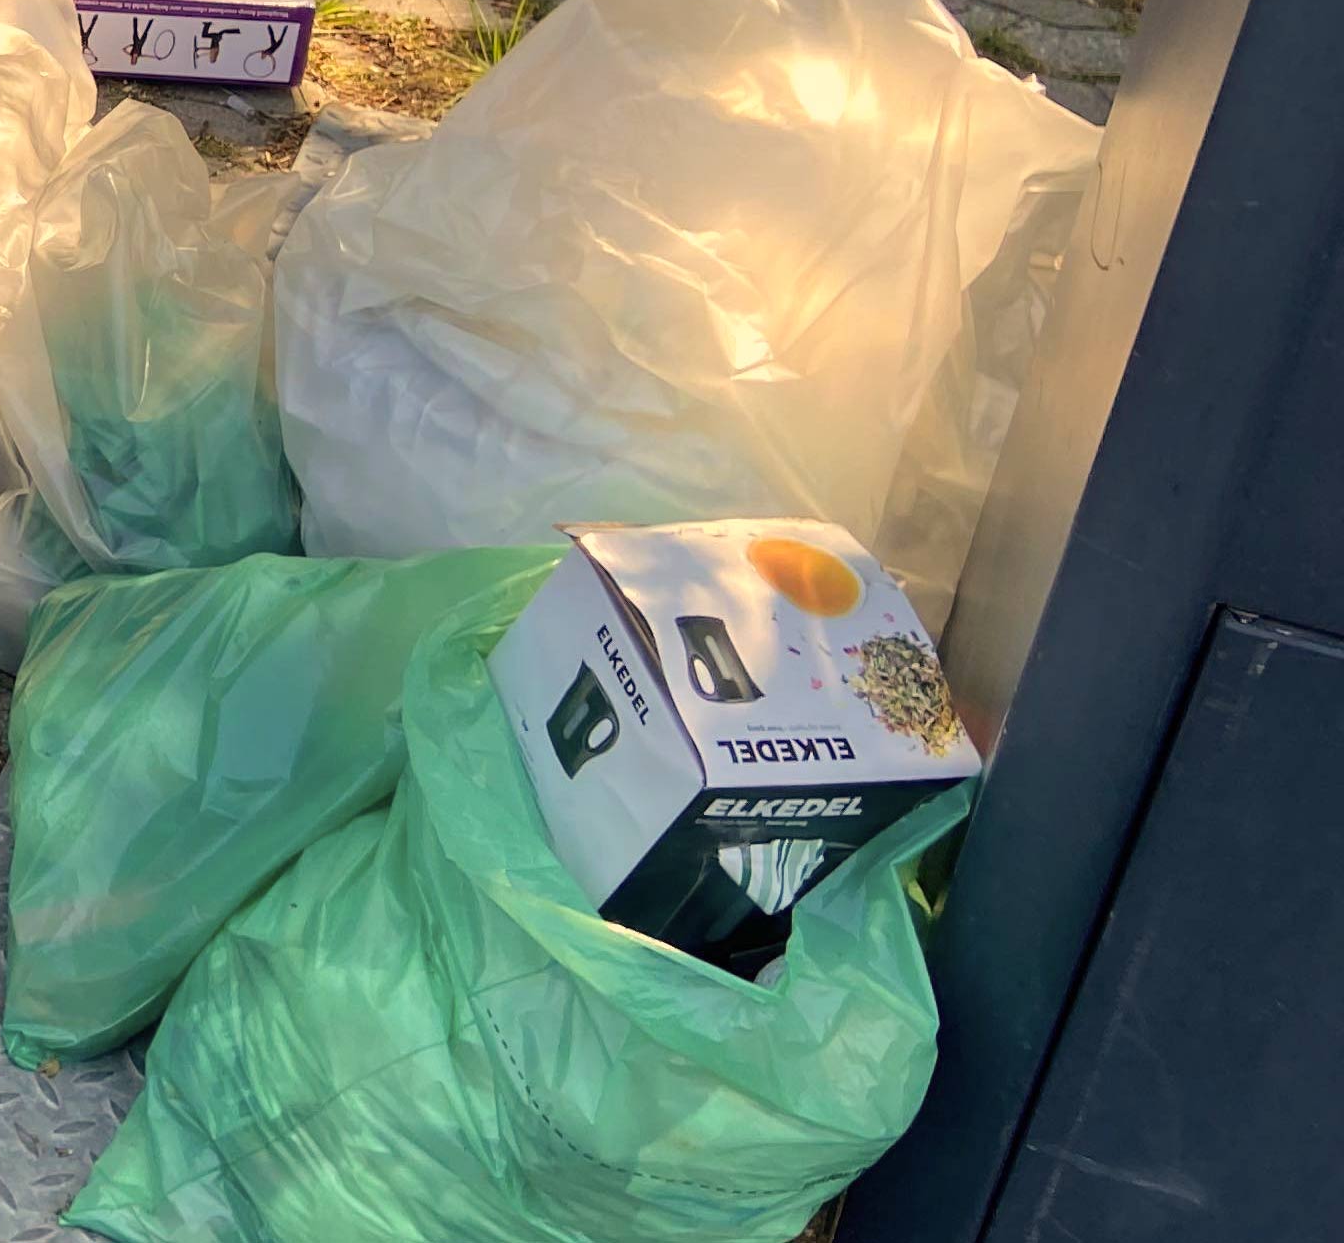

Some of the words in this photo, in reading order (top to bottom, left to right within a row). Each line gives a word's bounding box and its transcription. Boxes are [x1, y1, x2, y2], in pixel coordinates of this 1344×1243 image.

[596, 623, 650, 726] ELKEDEL
[717, 737, 857, 765] ELKEDEL
[703, 796, 864, 818] ELKEDEL
